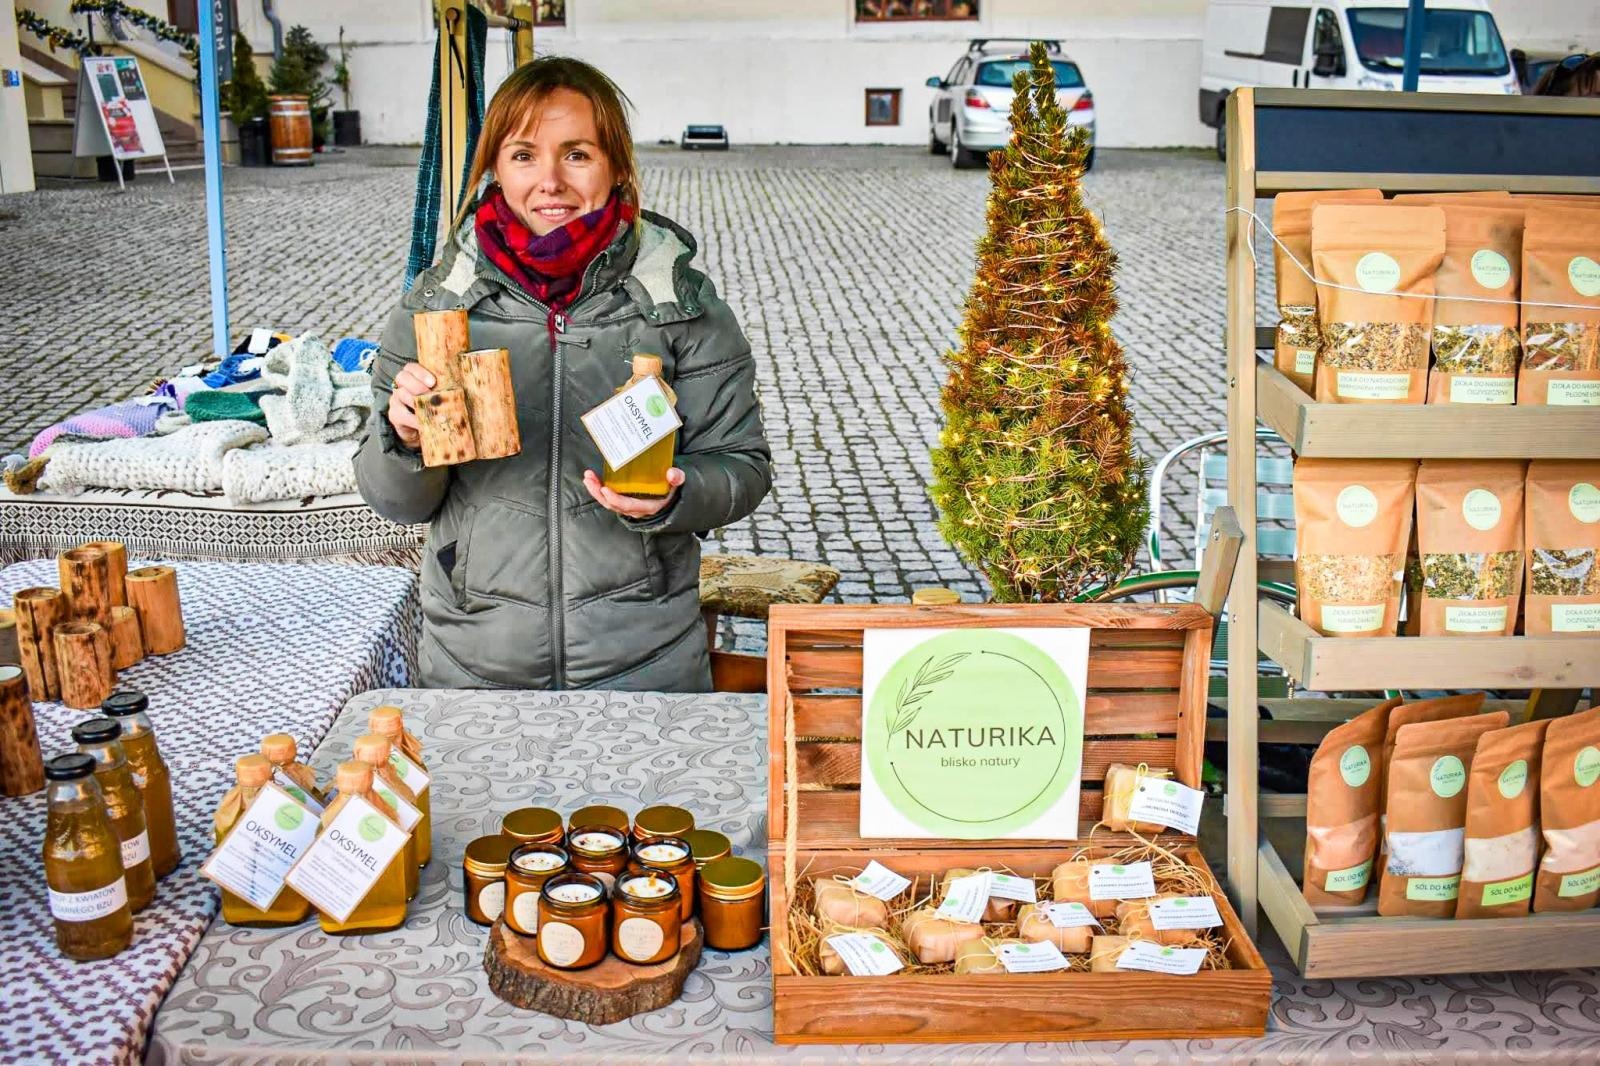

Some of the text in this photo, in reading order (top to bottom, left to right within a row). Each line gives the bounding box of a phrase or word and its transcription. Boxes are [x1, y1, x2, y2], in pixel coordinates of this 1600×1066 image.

[624, 395, 653, 439] OKSYMEL
[906, 726, 1056, 749] NATURIKA
[941, 757, 1020, 769] blisko natury
[245, 820, 297, 859] OKSYMEL
[329, 829, 379, 872] OKSYMEL
[97, 900, 113, 910] BZU
